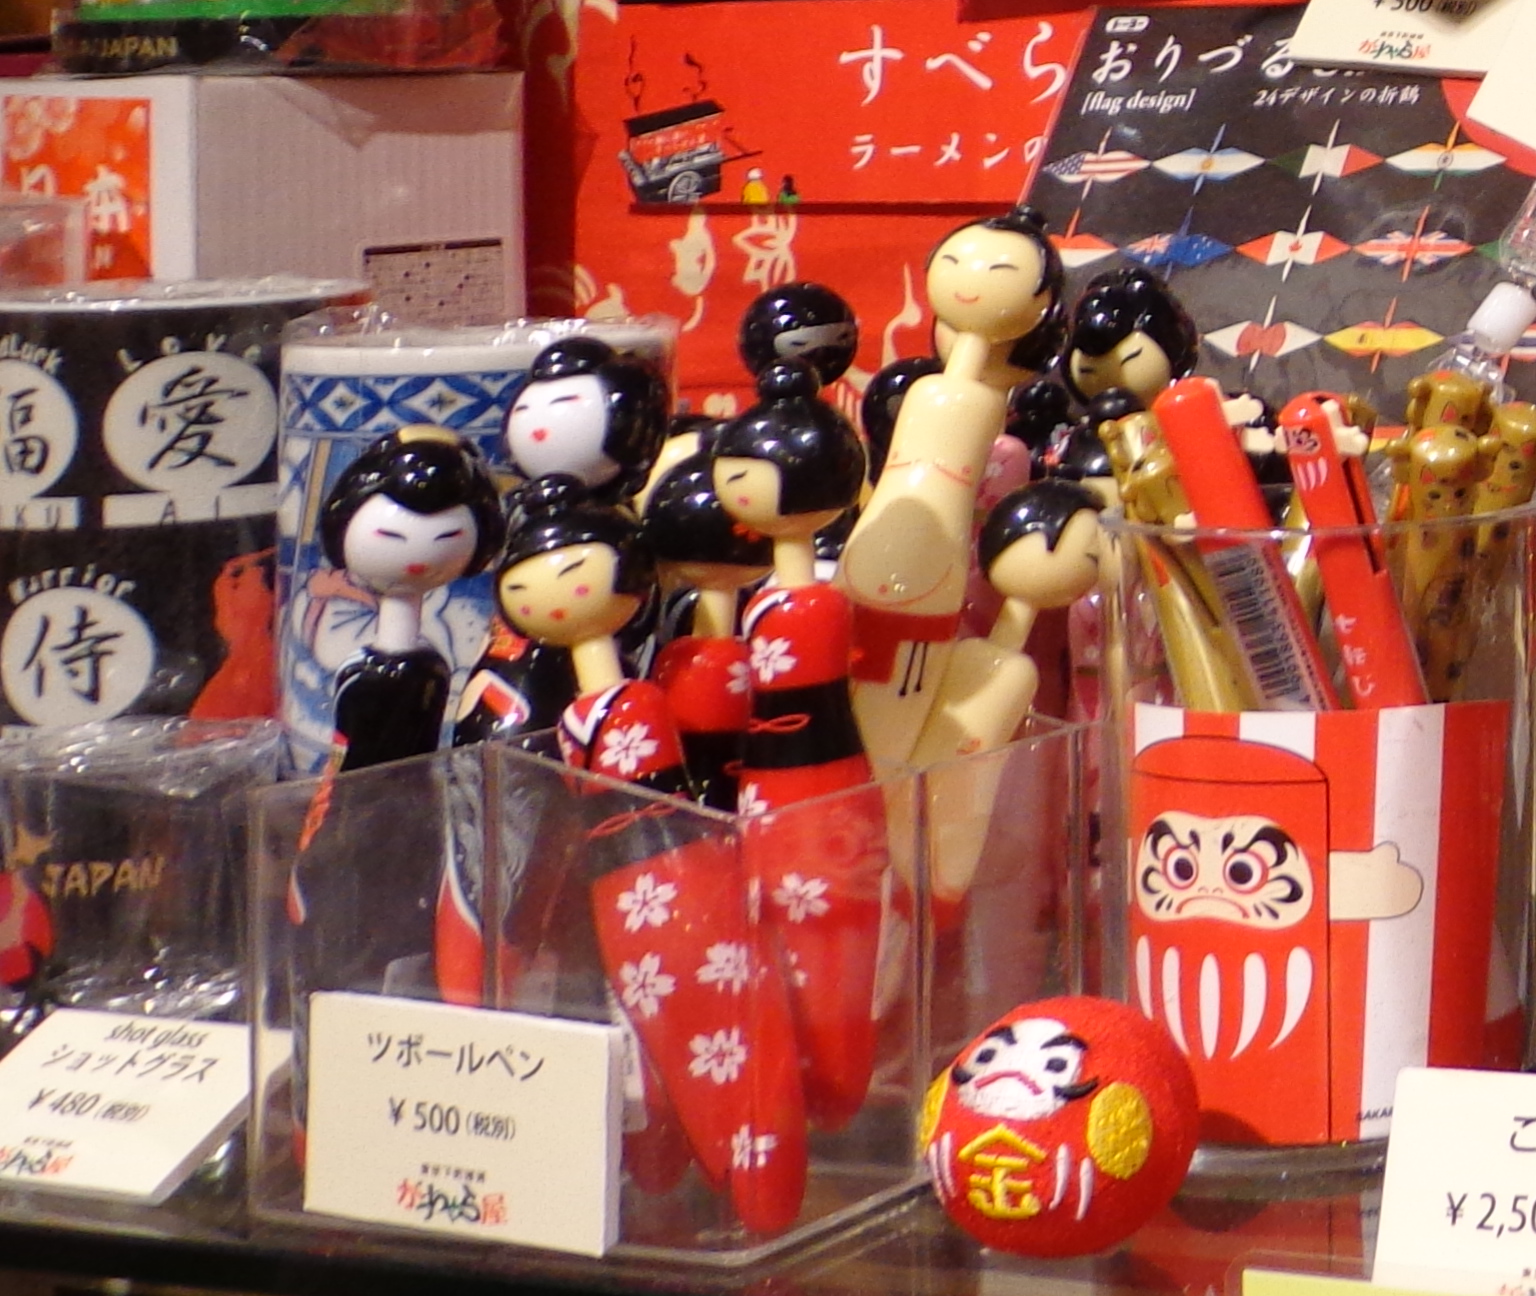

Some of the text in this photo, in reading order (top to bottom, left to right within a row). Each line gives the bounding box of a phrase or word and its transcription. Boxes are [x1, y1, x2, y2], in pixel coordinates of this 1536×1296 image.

[1081, 87, 1198, 116] [flag design]
[139, 366, 249, 471] 愛
[23, 604, 126, 703] 侍
[43, 855, 165, 899] JAPAN
[147, 1023, 209, 1051] glass
[41, 1043, 220, 1084] ショットグラス
[956, 1124, 1046, 1221] 金
